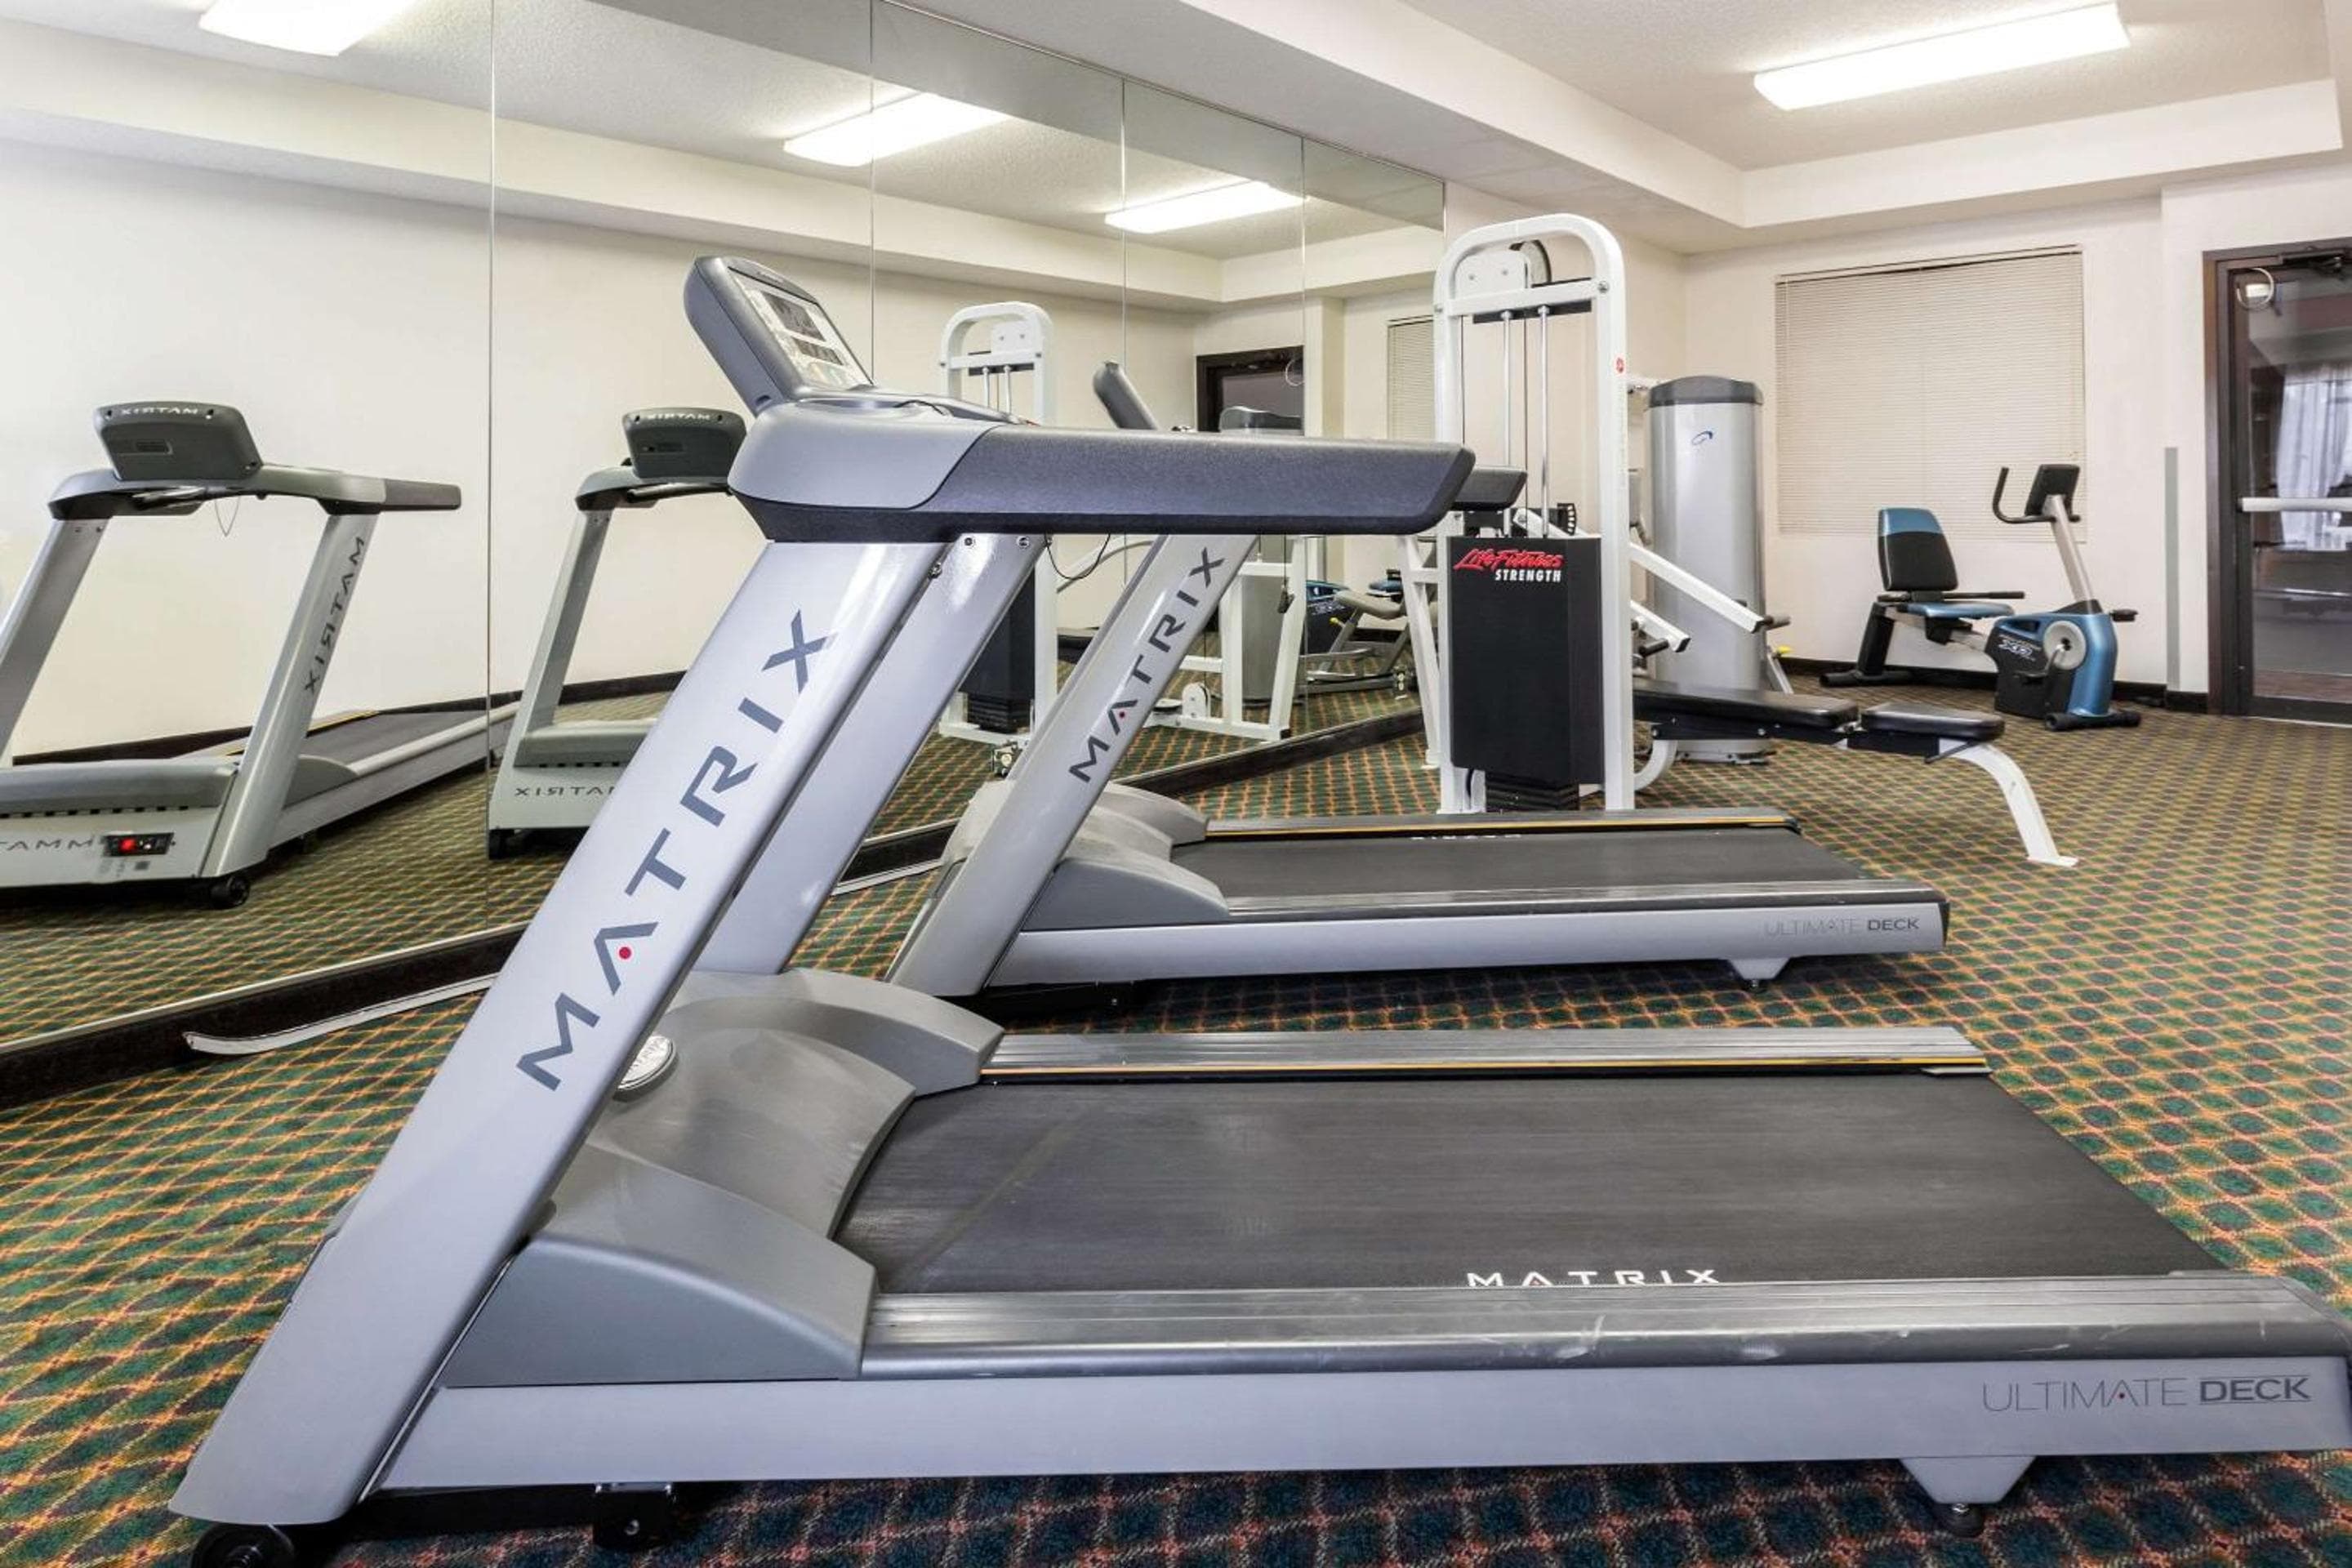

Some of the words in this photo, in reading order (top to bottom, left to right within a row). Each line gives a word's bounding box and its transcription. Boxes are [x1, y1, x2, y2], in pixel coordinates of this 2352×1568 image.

[1494, 568, 1562, 582] STRENGTH
[1068, 546, 1225, 783] MATRIX
[515, 608, 836, 1092] MATRIX
[1867, 917, 1920, 932] DECK
[1466, 1268, 1719, 1287] MATRIX
[1982, 1377, 2188, 1412] ULTIMATE
[2199, 1374, 2311, 1405] DECK
